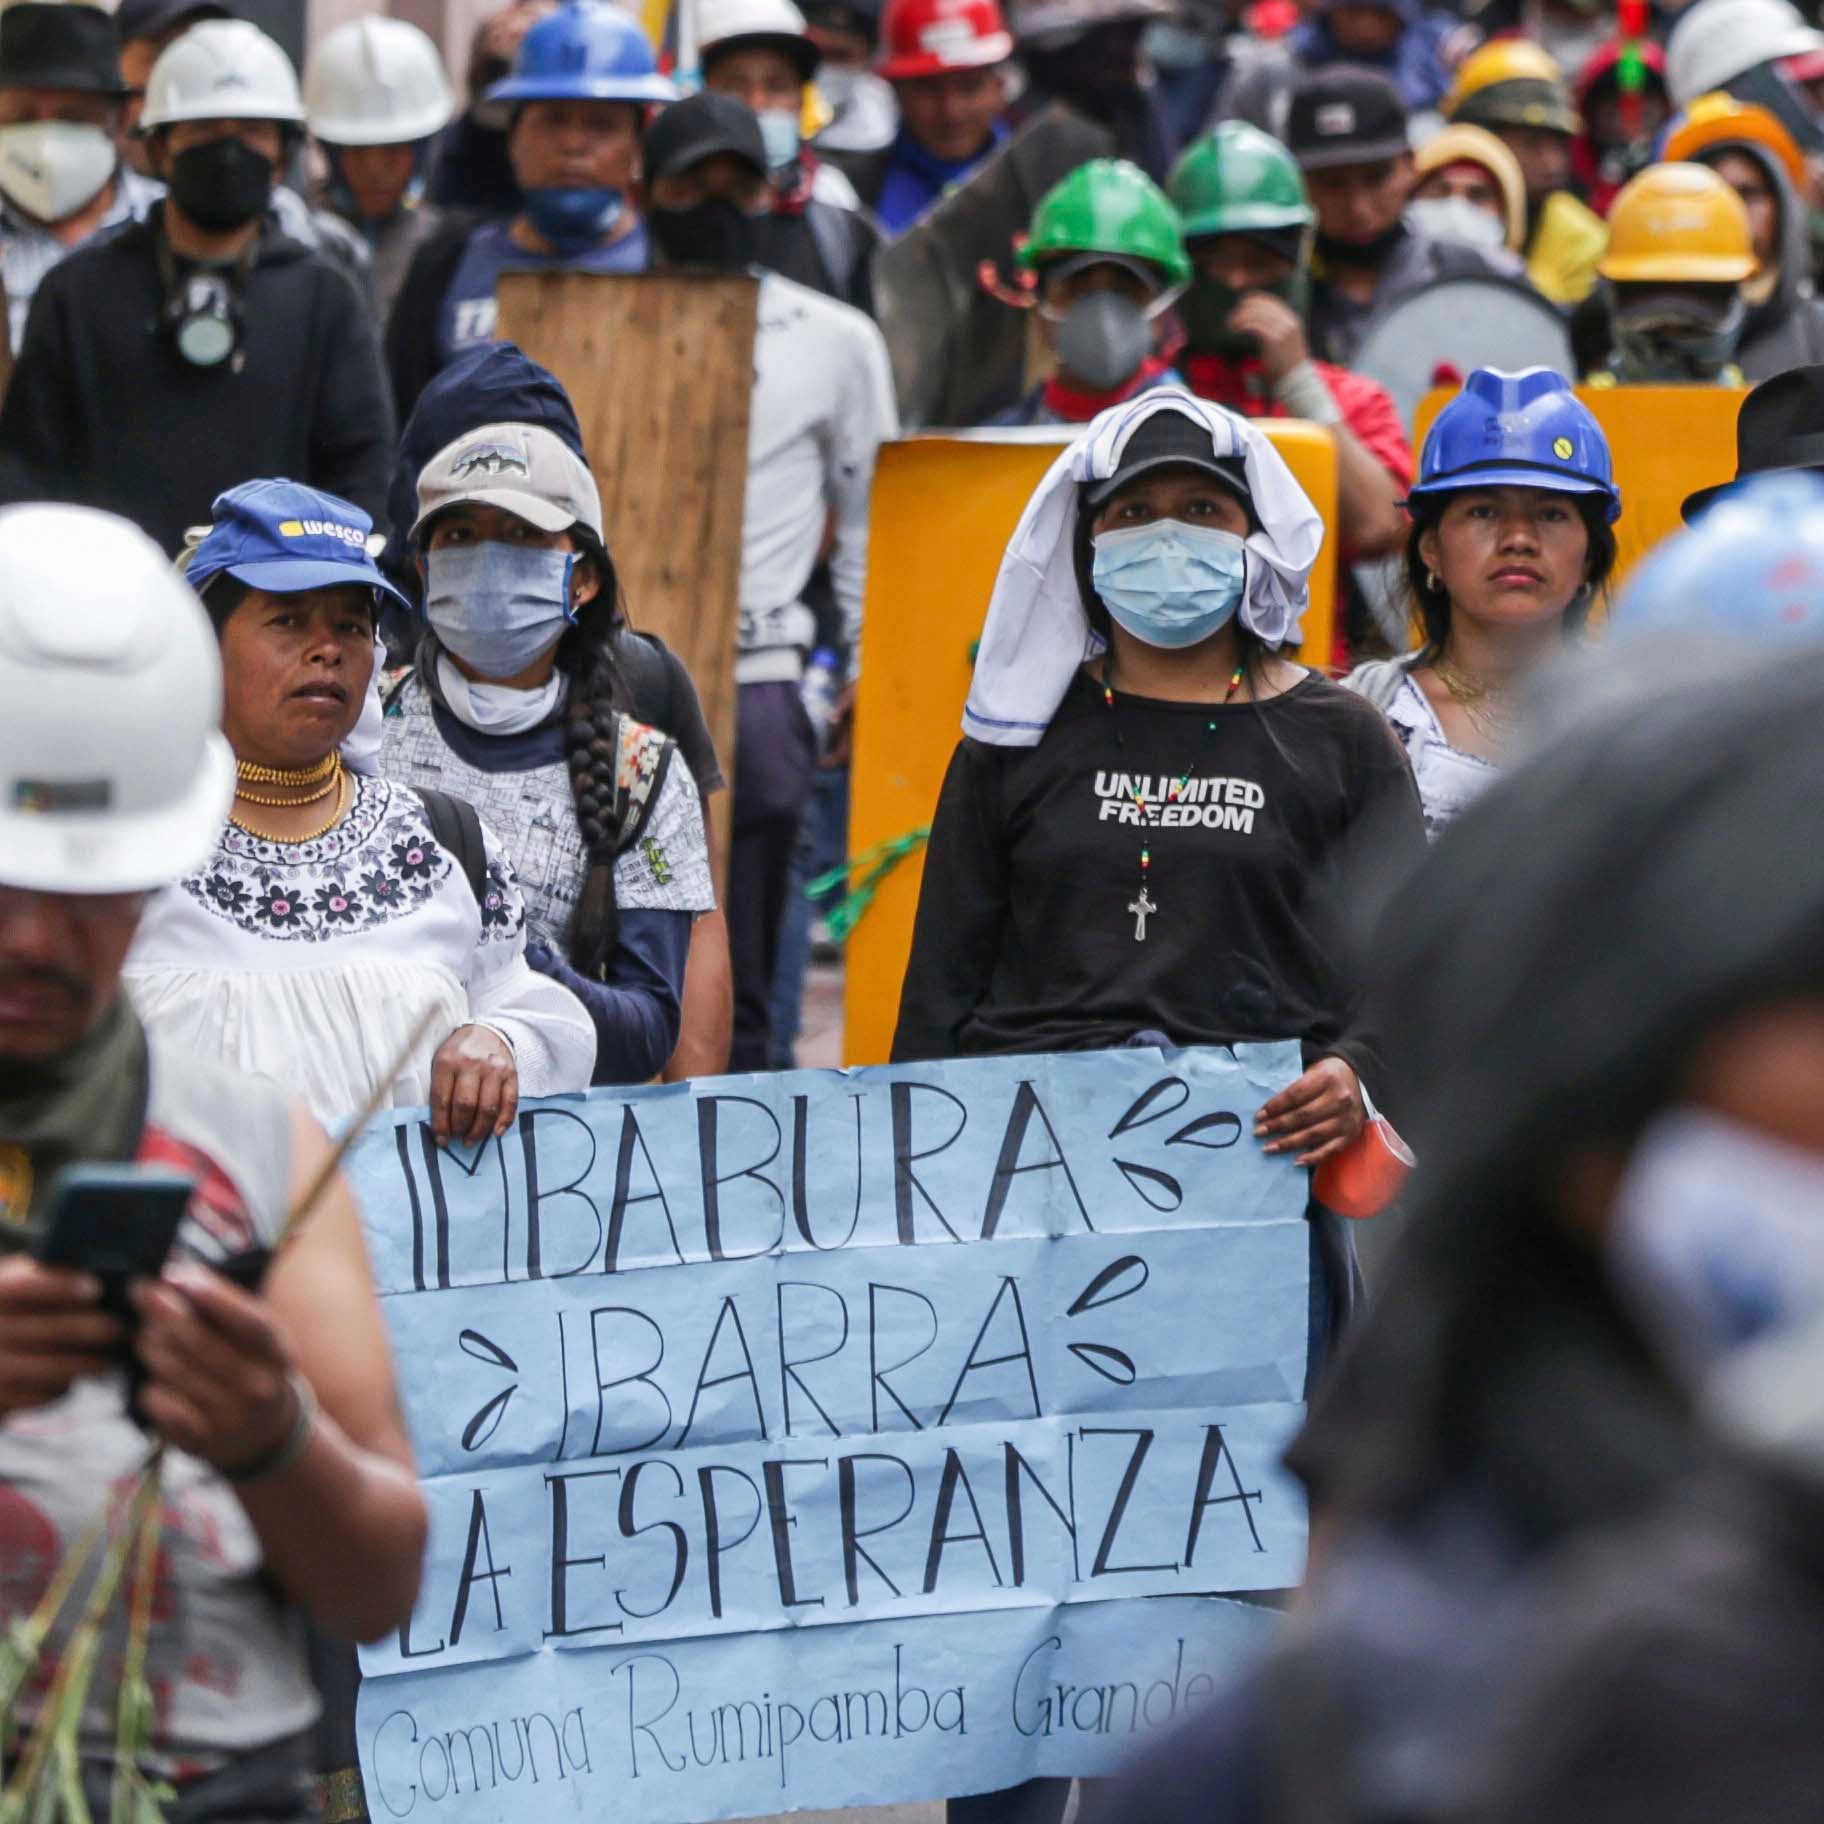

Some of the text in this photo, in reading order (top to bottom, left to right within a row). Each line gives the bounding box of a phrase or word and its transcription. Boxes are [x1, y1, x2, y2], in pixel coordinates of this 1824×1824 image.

[303, 519, 365, 543] wesco
[1094, 771, 1265, 809] UNLIMITED
[1098, 799, 1255, 835] FREEDOM
[394, 1079, 1099, 1292] IMBABURA
[555, 1274, 1042, 1462] IBARRA
[543, 1422, 1270, 1640] ESPERANZA
[372, 1635, 1213, 1820] Comuna Rumipamba Grande
